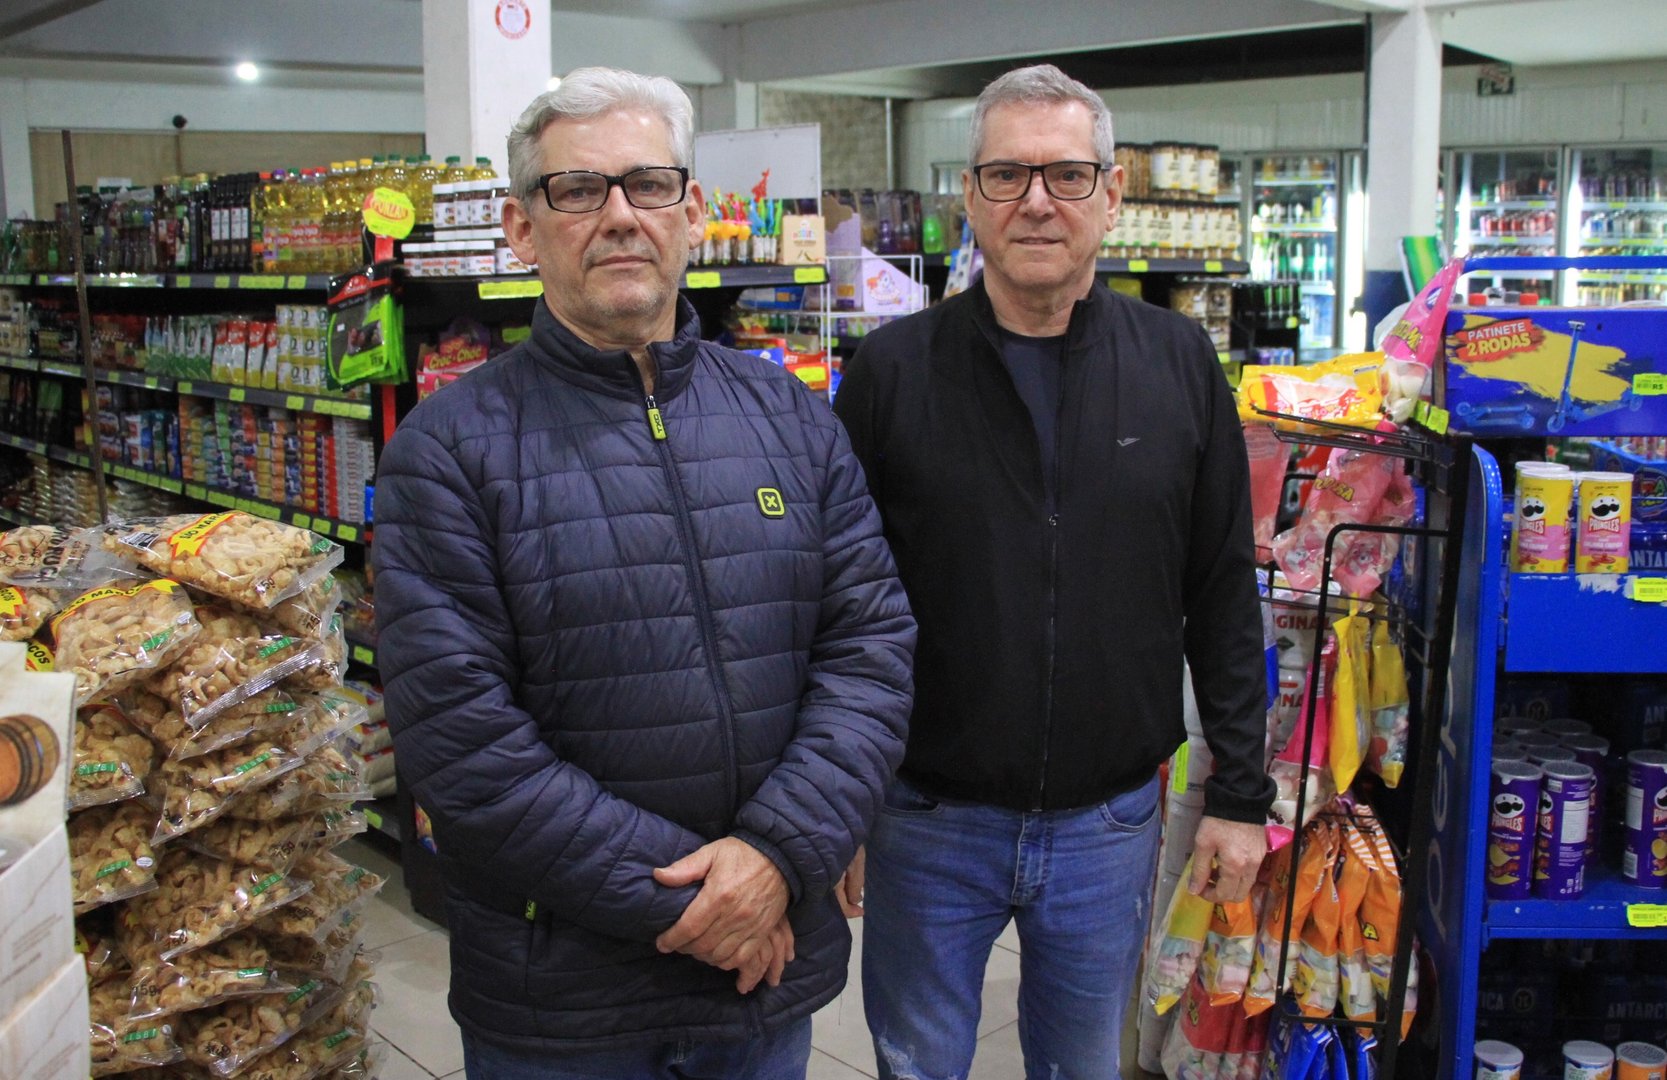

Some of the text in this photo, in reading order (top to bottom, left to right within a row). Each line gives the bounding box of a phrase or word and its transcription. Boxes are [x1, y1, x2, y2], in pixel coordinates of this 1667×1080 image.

[1467, 321, 1526, 341] PATINETE
[1467, 332, 1531, 356] 2 RODAS
[1589, 516, 1620, 533] PRINGLES
[1492, 813, 1523, 832] PRINGLES
